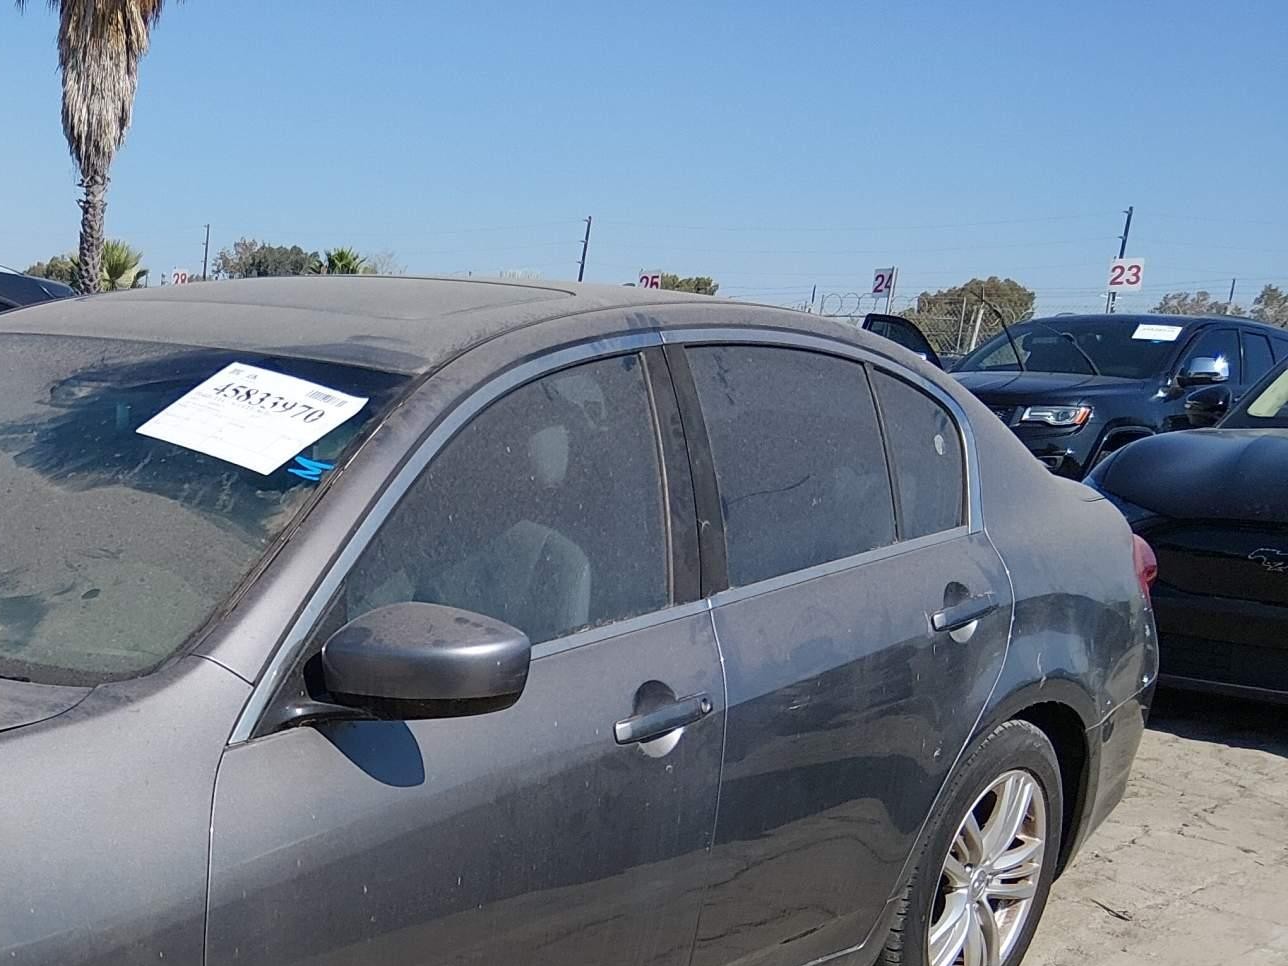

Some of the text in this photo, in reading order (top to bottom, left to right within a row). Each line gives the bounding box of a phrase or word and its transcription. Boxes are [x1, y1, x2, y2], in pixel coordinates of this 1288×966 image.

[872, 273, 893, 293] 24
[1109, 264, 1142, 286] 23
[213, 382, 325, 424] 45833970
